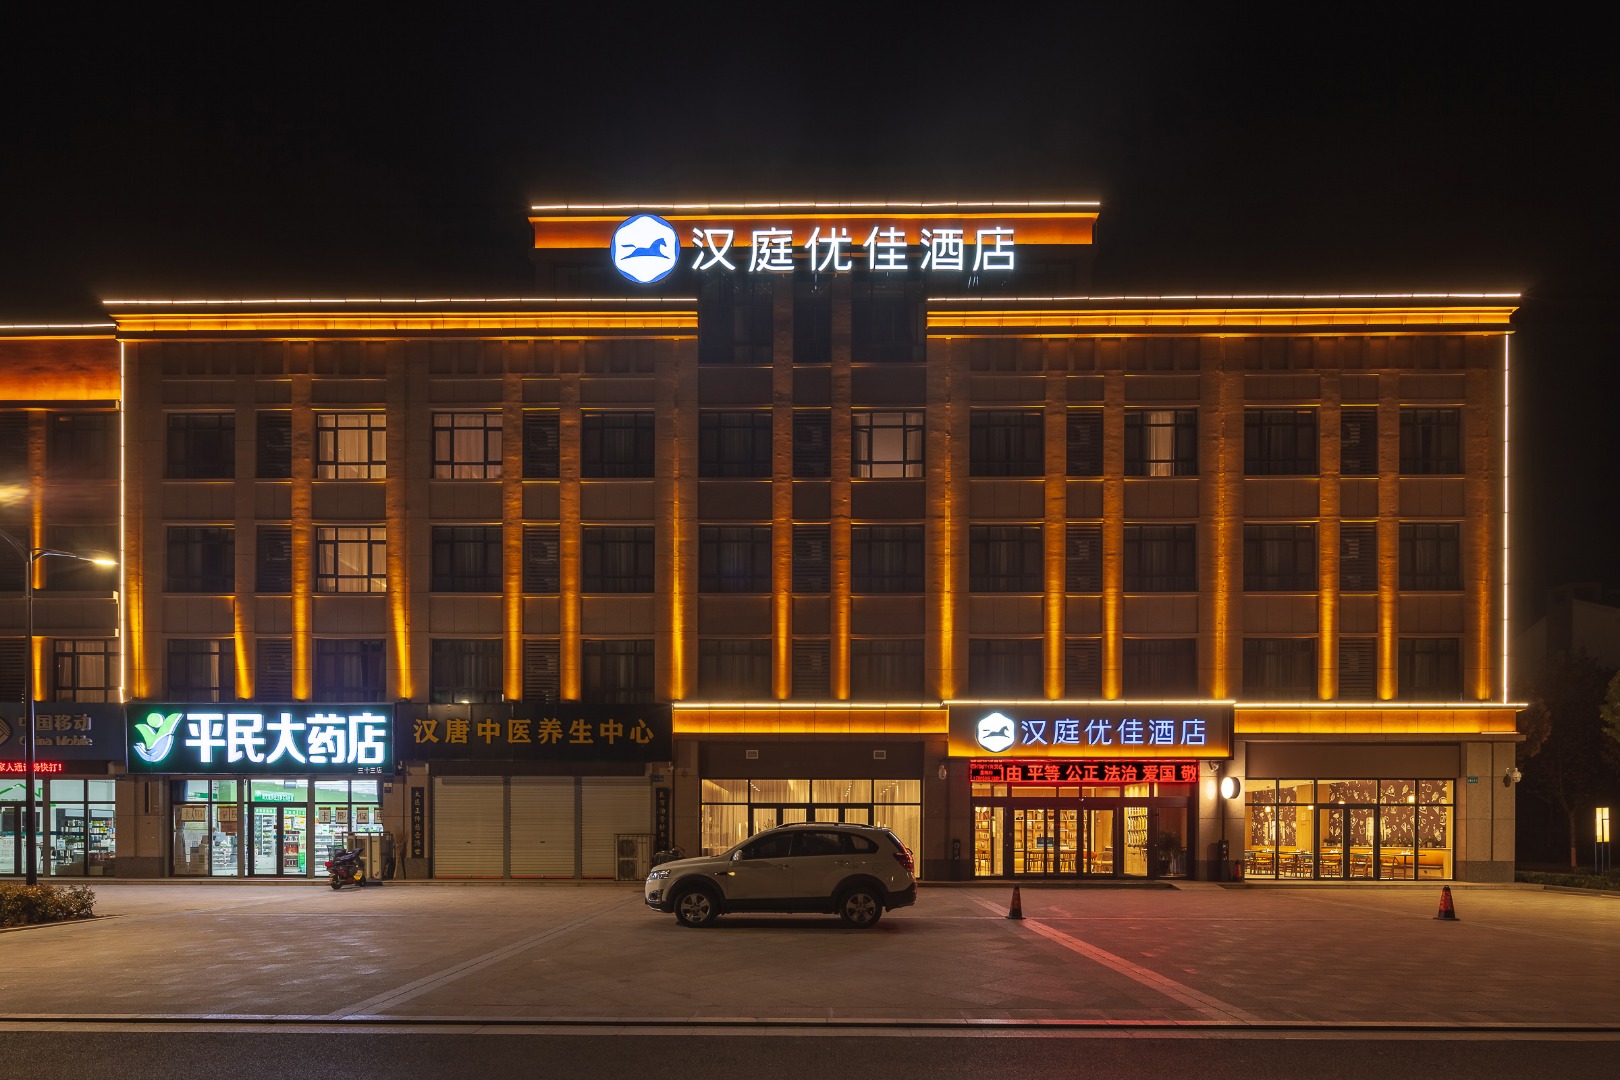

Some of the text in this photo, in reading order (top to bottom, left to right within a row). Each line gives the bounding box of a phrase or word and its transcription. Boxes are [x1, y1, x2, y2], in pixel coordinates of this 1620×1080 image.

[691, 227, 1015, 273] 汉庭优佳酒店
[56, 734, 93, 746] Mobile
[185, 712, 387, 764] 平民大药店
[413, 718, 655, 745] 汉唐中医养生中心
[1021, 718, 1206, 745] 汉庭优佳酒店
[357, 766, 382, 774] 三十三店
[1028, 765, 1060, 781] 平等
[1066, 765, 1099, 781] 公正
[1104, 765, 1137, 781] 法治
[1142, 765, 1176, 781] 爱国
[1181, 765, 1197, 781] 敬
